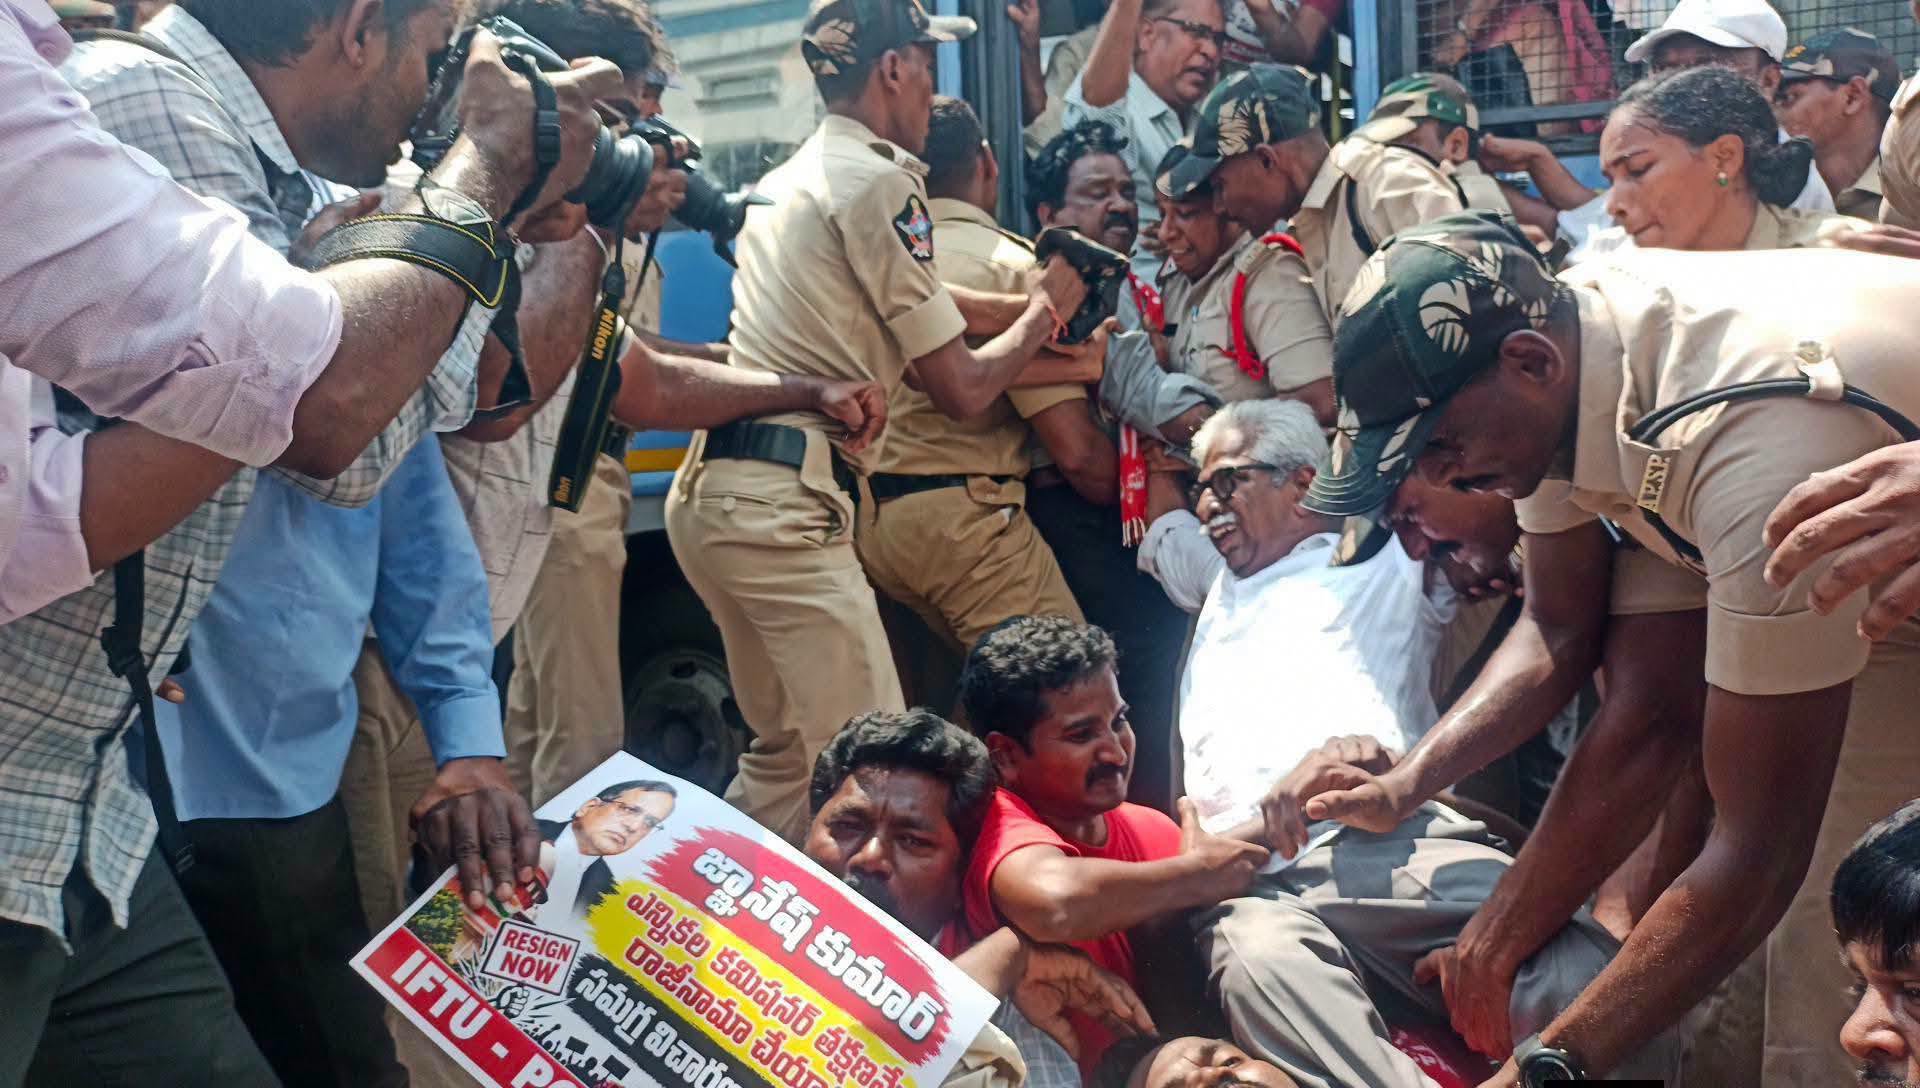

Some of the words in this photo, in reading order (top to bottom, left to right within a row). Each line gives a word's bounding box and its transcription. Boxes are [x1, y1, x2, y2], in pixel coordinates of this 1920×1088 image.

[592, 308, 616, 360] Nikon
[499, 951, 560, 985] NOW
[503, 929, 572, 962] RESIGN
[626, 892, 711, 958] ఎన్నికల
[709, 946, 823, 1037] కమిషనర్
[806, 925, 944, 1041] కుమార్
[391, 950, 492, 1040] IFTU
[575, 969, 657, 1045] సమగ్ర
[625, 937, 753, 1044] రాజీనామా
